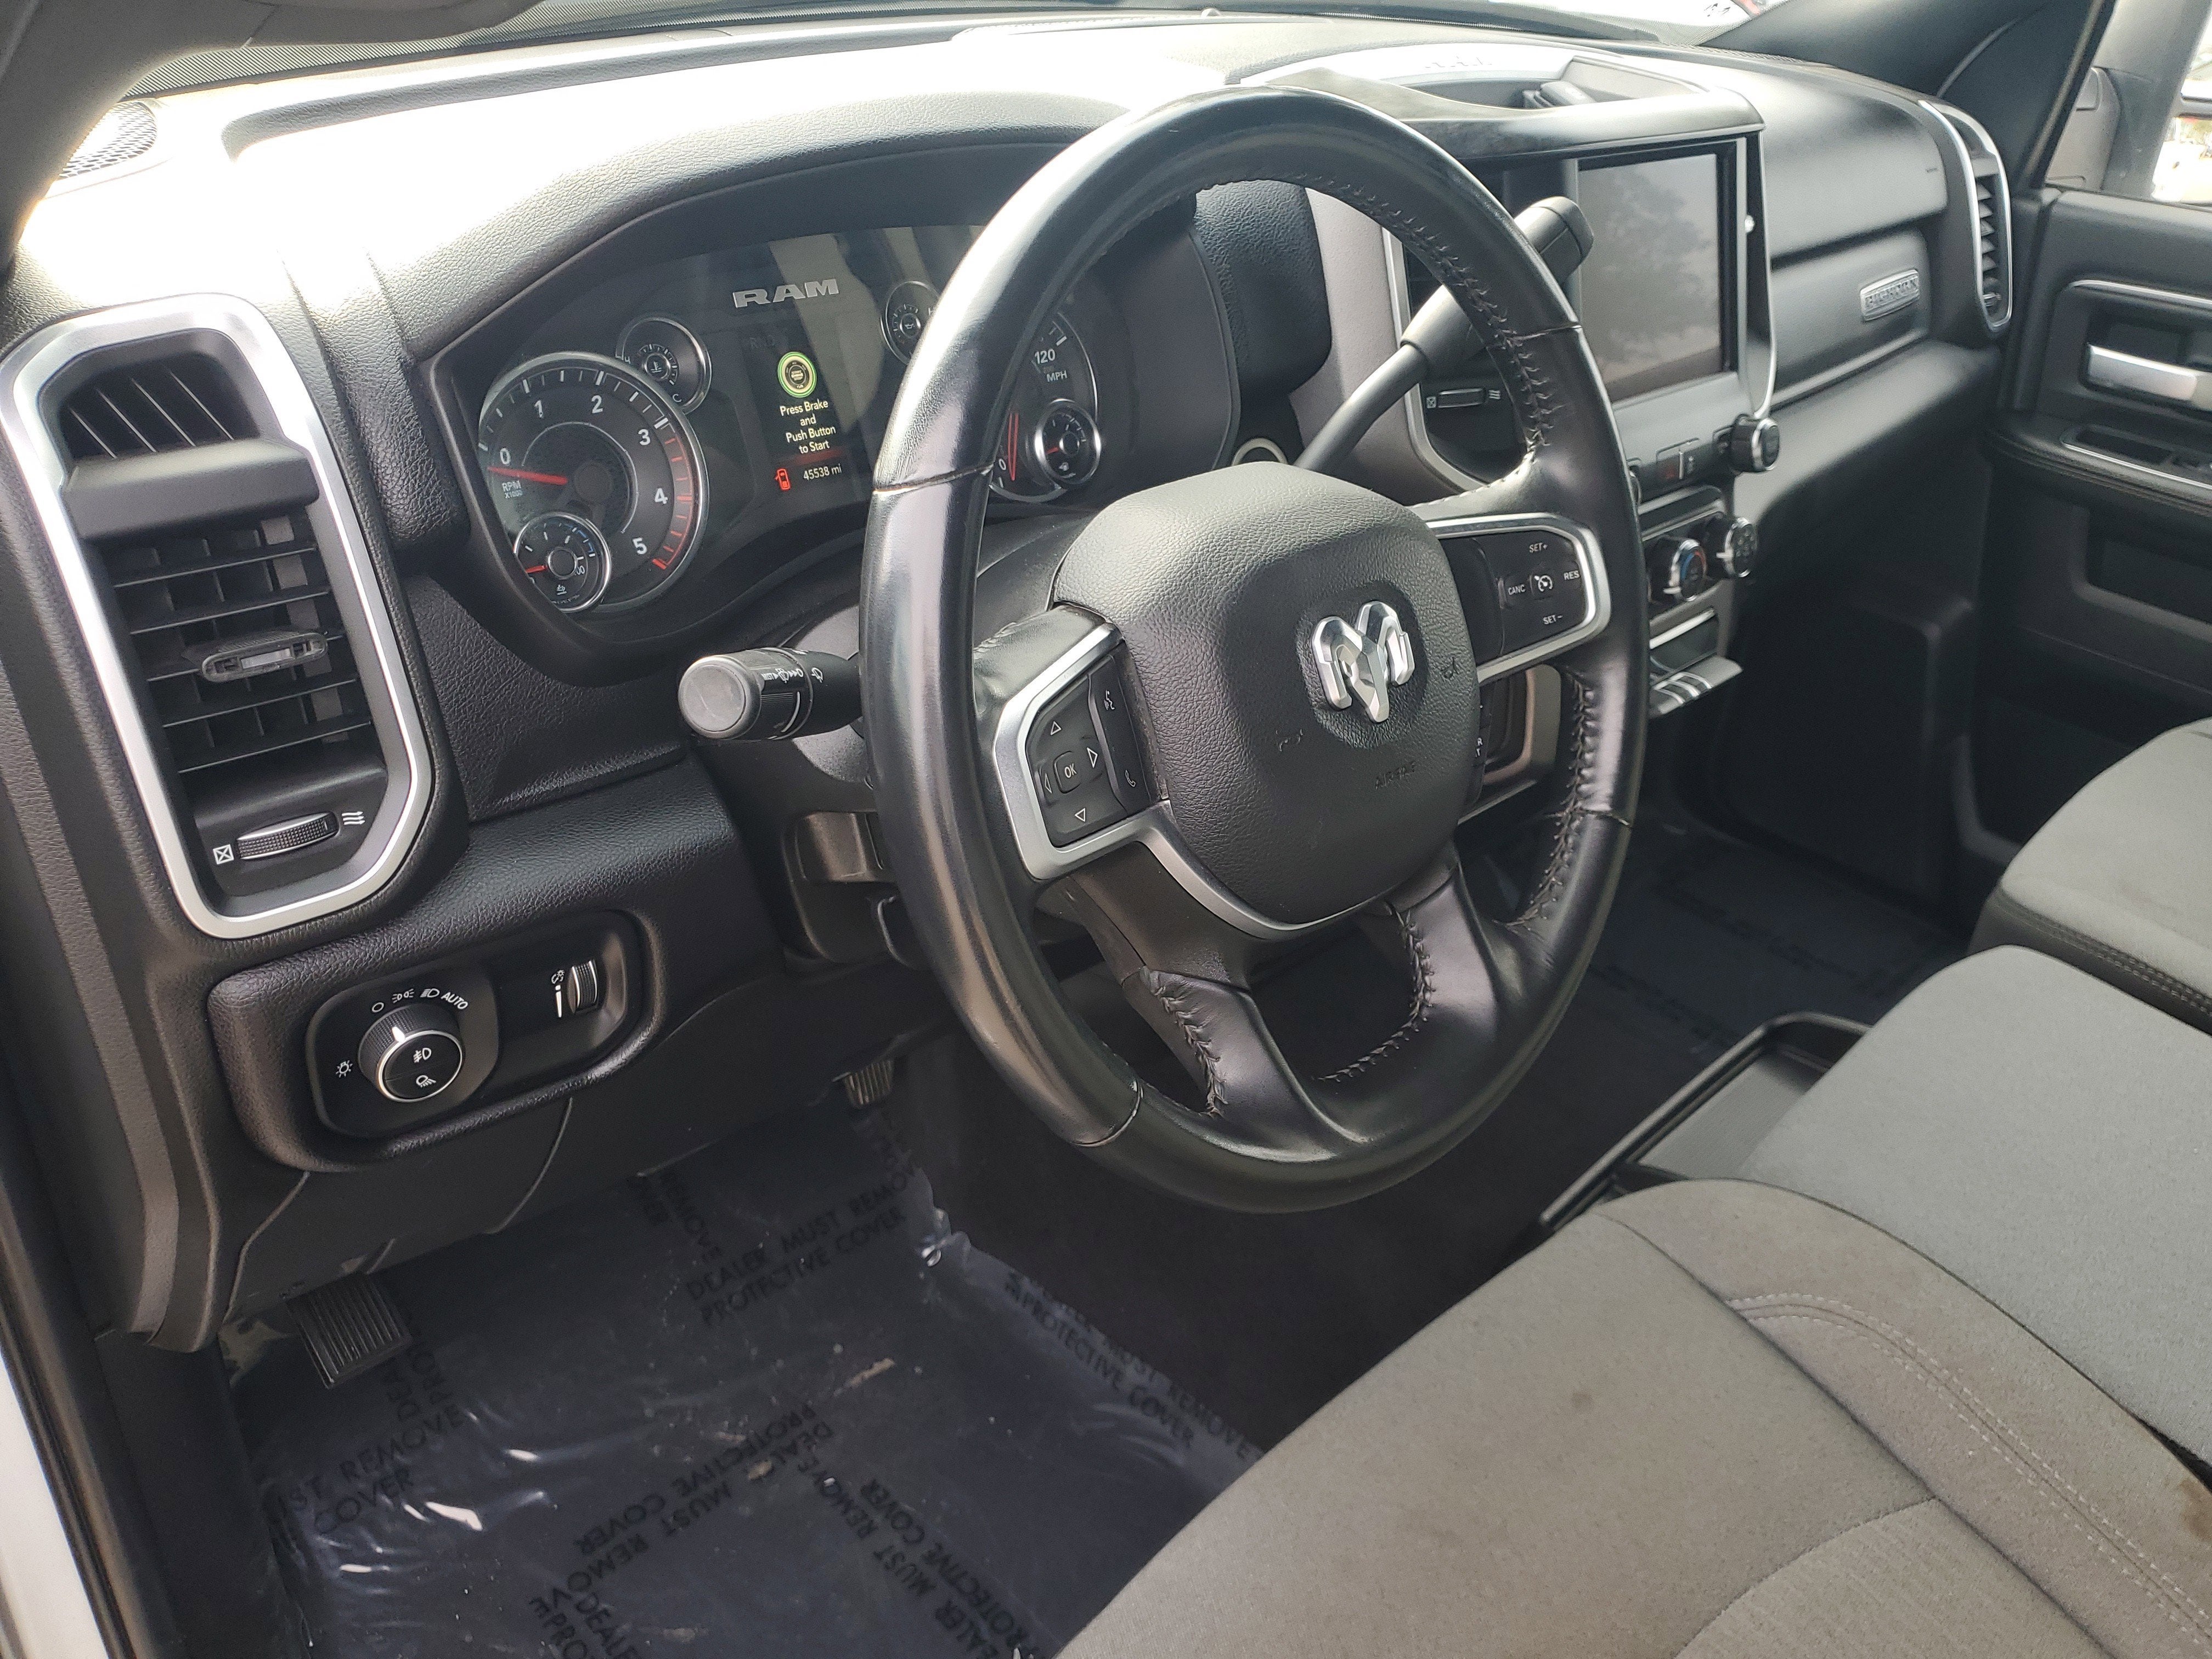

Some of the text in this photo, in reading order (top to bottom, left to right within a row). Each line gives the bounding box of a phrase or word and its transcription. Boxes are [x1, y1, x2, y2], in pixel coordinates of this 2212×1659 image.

[732, 278, 839, 308] RAM
[1034, 348, 1056, 364] 120
[1046, 370, 1068, 382] MPH
[591, 395, 604, 414] 2
[672, 393, 682, 402] C
[534, 399, 544, 419] 1
[780, 398, 828, 416] Press Brake
[800, 414, 817, 426] and
[637, 428, 651, 447] 3
[786, 426, 837, 443] Push Button
[799, 441, 830, 454] to Start
[500, 449, 511, 466] 0
[803, 463, 842, 481] 45538 mi
[501, 481, 522, 492] RPM
[654, 488, 668, 506] 4
[633, 538, 647, 555] 5
[1564, 570, 1581, 580] RES
[1508, 584, 1526, 596] CANC
[1064, 763, 1078, 779] OK
[441, 992, 469, 1009] AUTO
[339, 1403, 464, 1484] REMOVE
[660, 1480, 732, 1538] MUST
[573, 1493, 667, 1556] COVER
[529, 1532, 650, 1619] REMOVE
[872, 1544, 937, 1598] MUST
